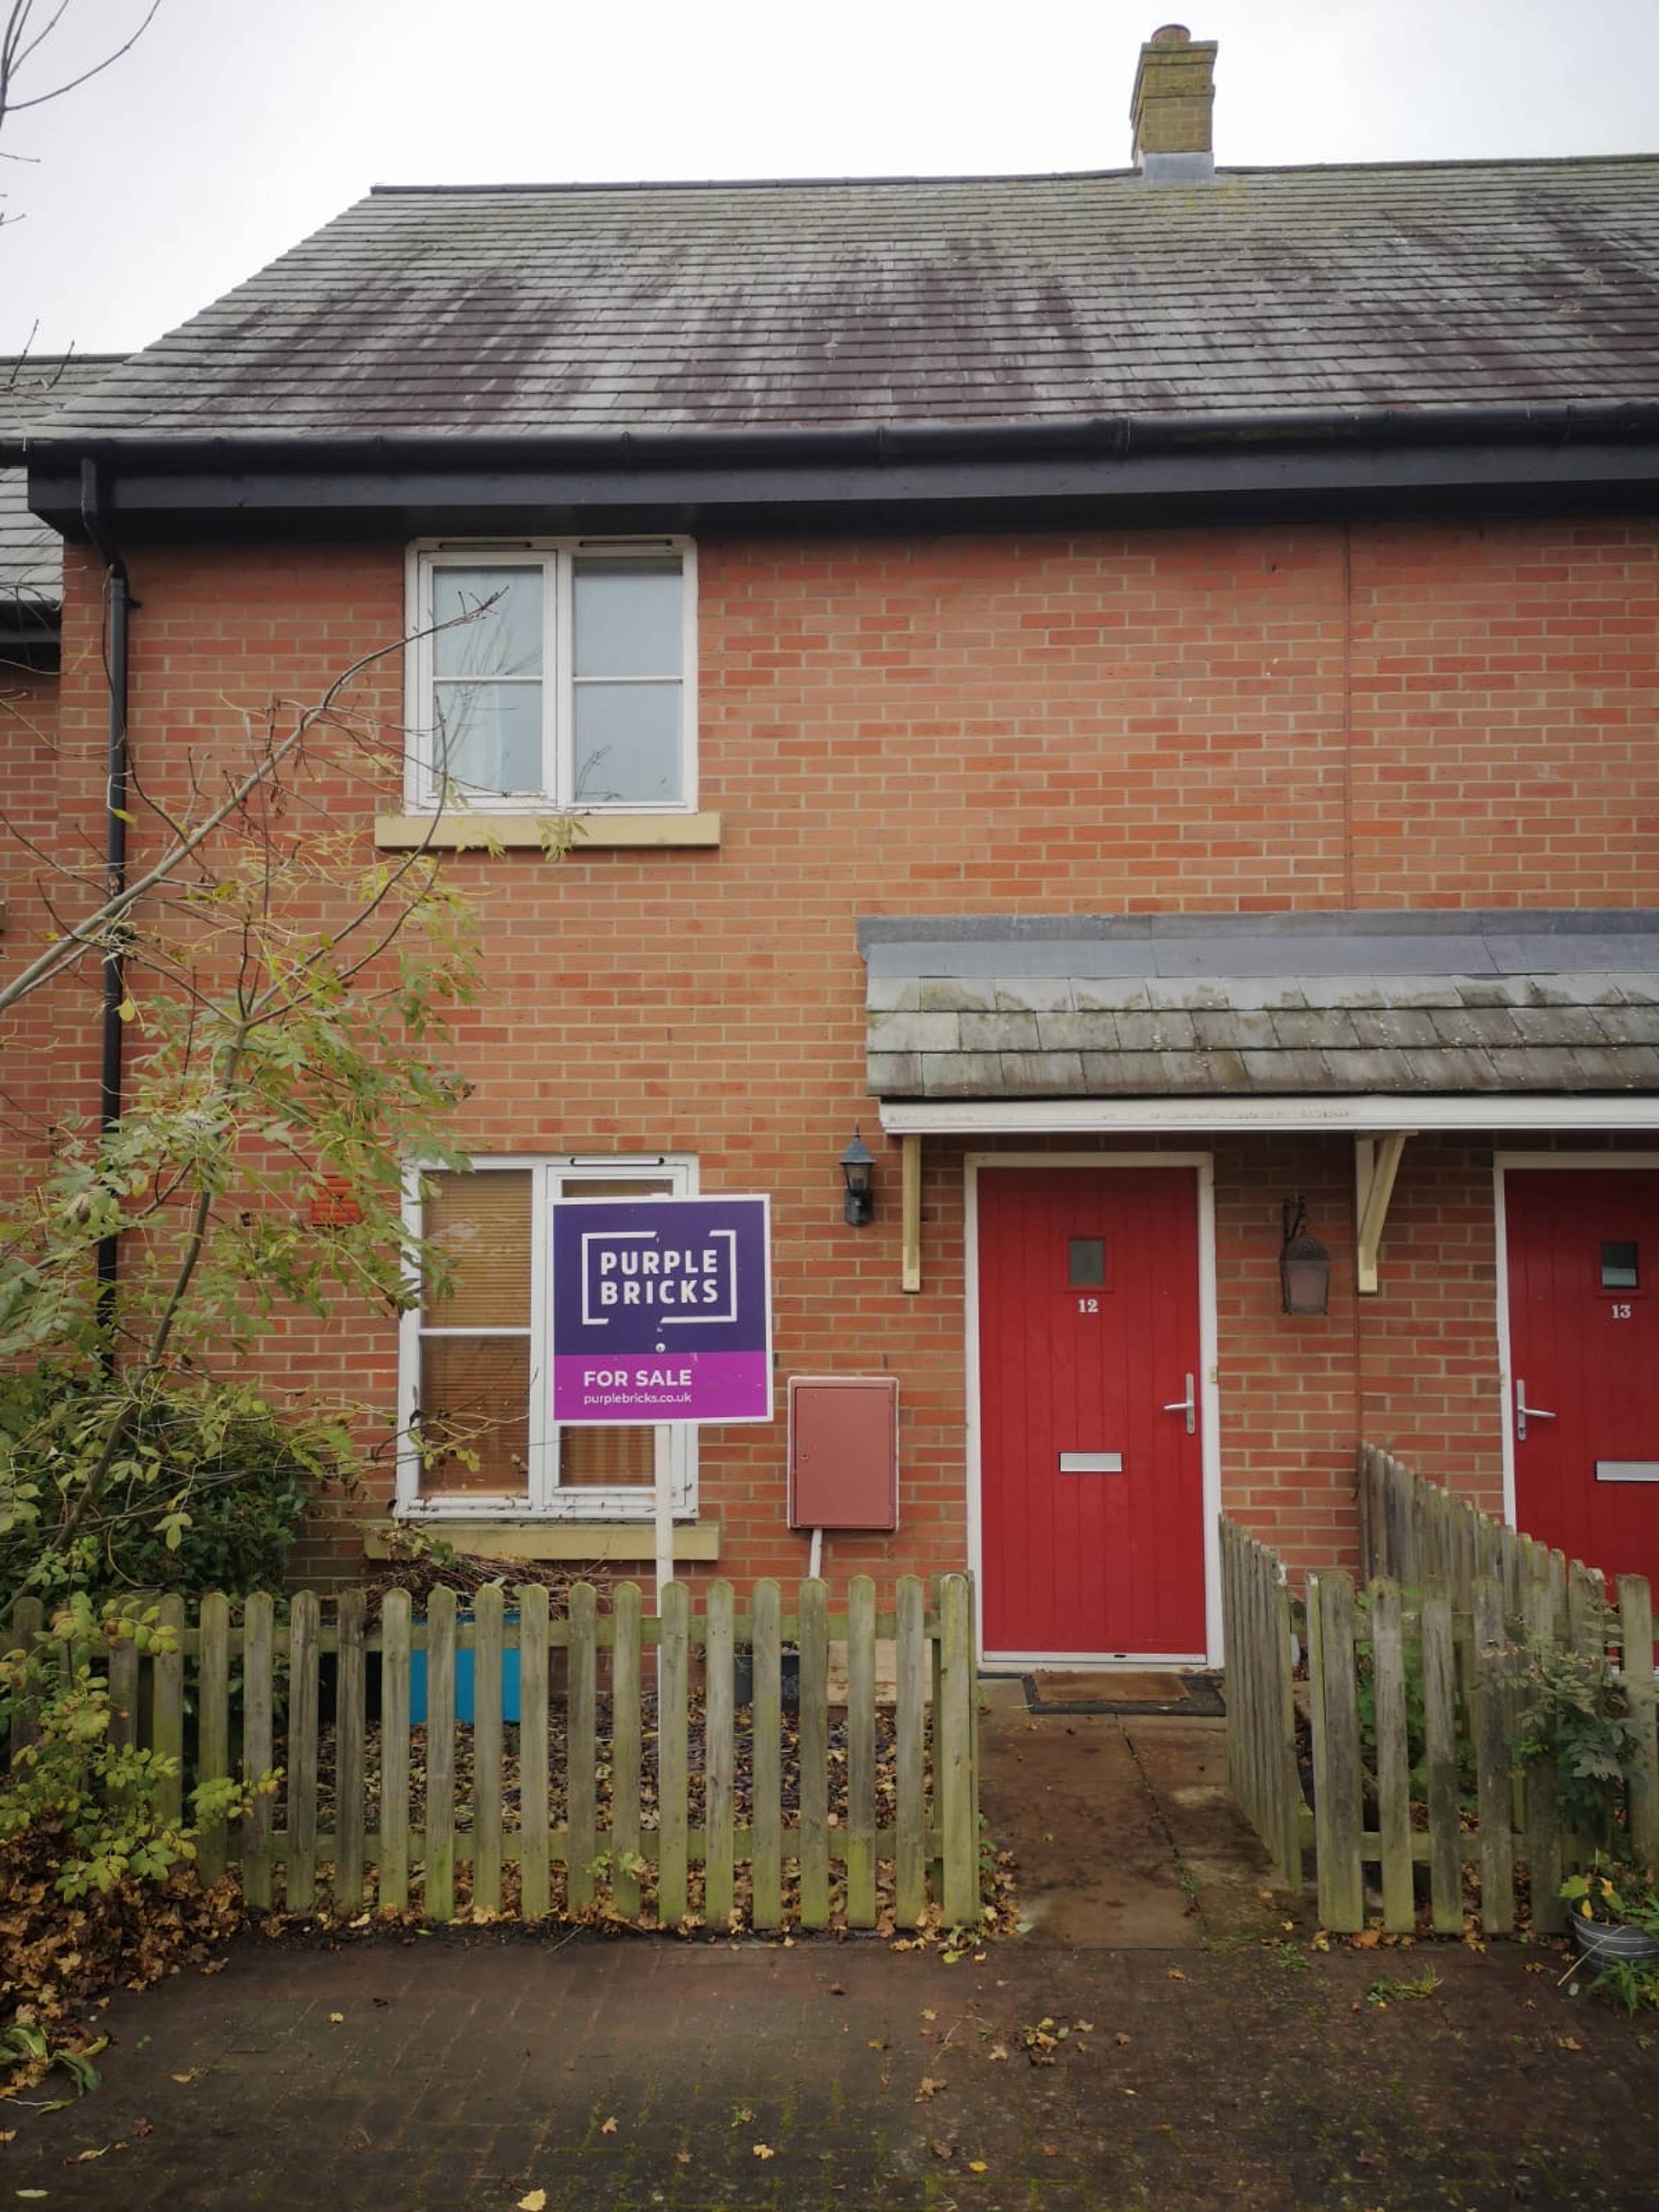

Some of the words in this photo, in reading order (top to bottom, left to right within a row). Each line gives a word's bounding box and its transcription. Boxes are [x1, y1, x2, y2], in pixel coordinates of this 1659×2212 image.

[601, 1249, 718, 1275] PURPLE
[601, 1279, 718, 1305] BRICKS
[1078, 1299, 1098, 1313] 12
[1611, 1305, 1631, 1318] 13
[584, 1371, 628, 1387] FOR
[636, 1370, 692, 1386] SALE
[584, 1391, 692, 1405] purplebricks.co.uk
